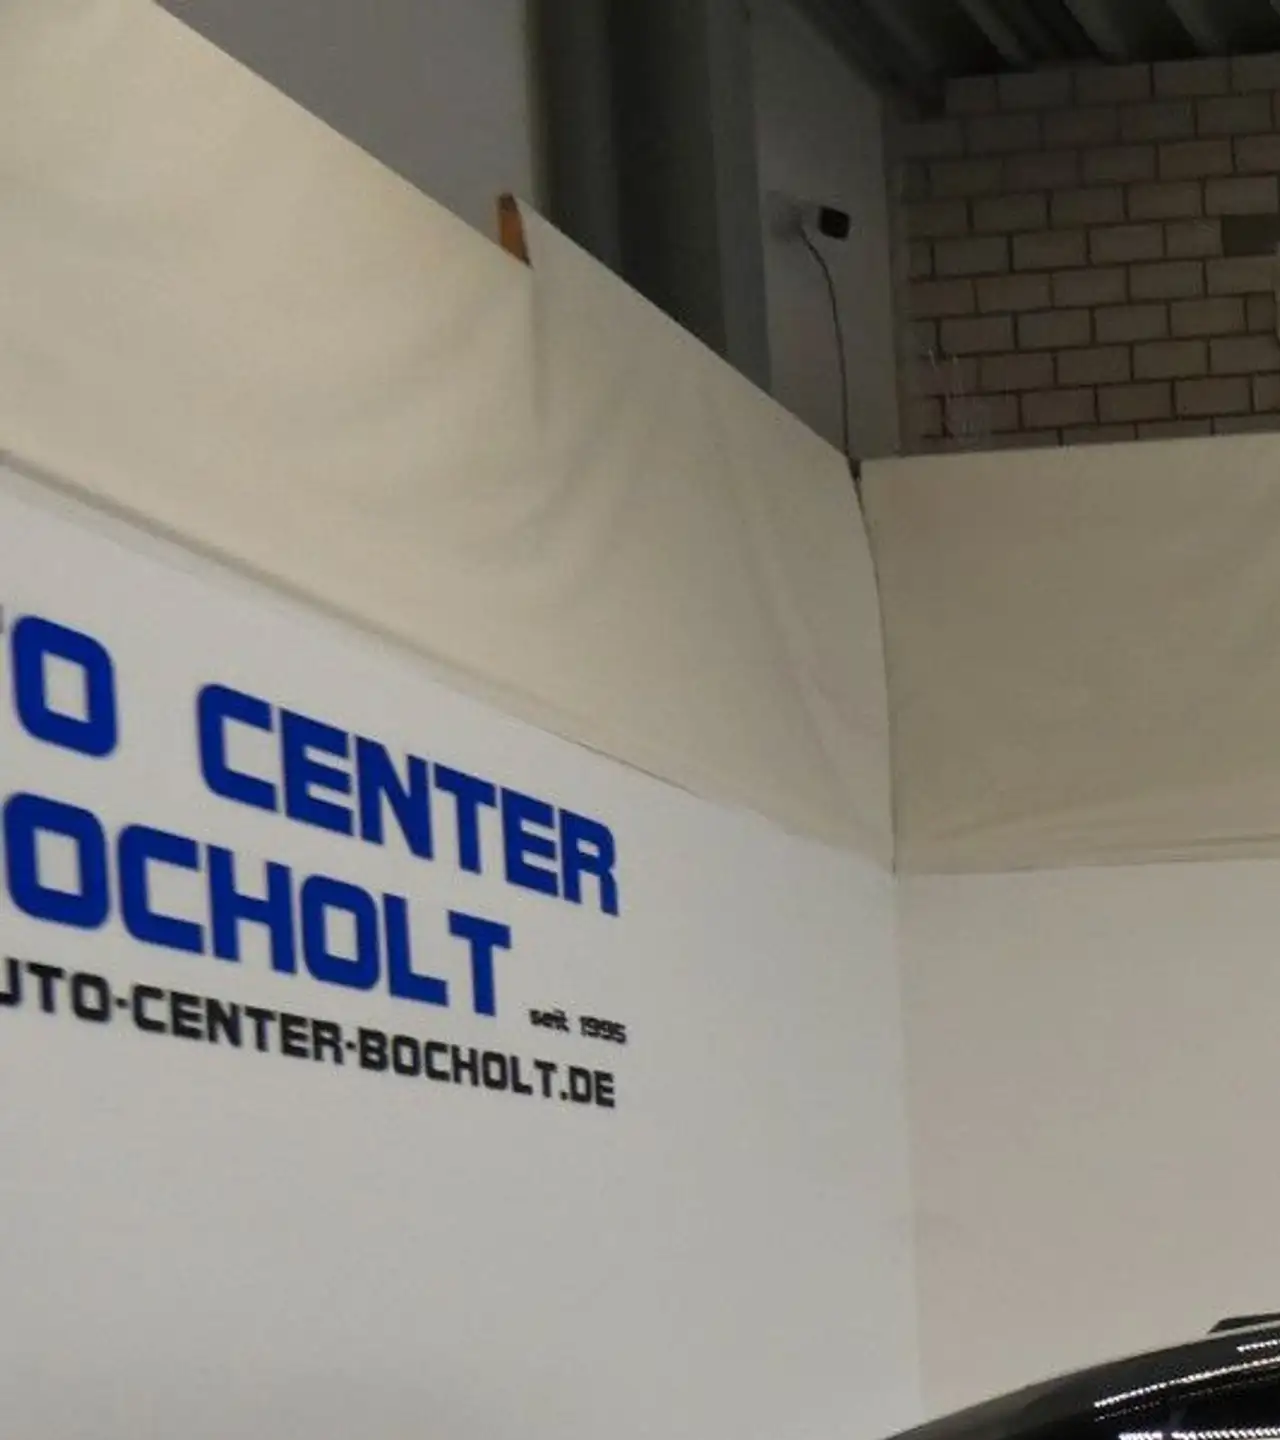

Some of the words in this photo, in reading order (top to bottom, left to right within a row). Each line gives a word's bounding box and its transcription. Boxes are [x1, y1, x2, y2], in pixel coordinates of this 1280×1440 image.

[0, 600, 118, 759] O
[197, 683, 619, 915] CENTER
[528, 1008, 570, 1033] seit
[579, 1015, 627, 1044] 1995
